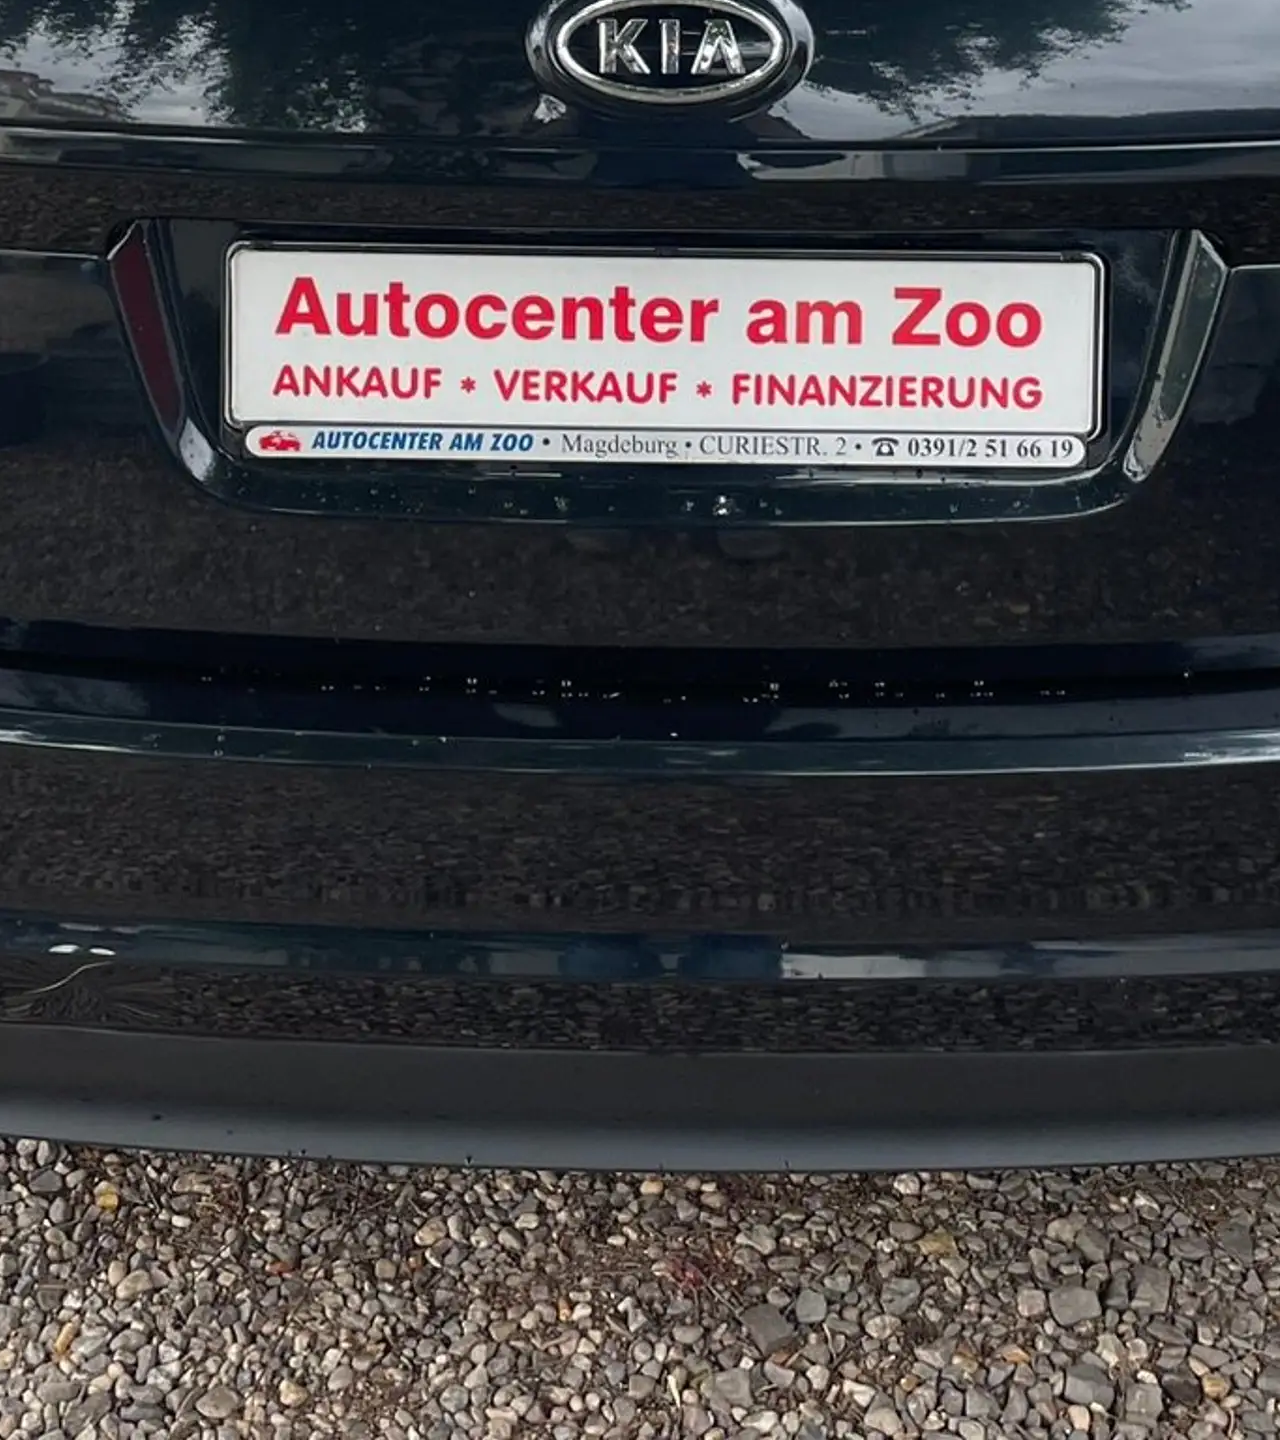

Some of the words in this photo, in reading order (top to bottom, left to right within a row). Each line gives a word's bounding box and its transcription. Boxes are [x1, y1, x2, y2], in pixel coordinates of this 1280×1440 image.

[595, 17, 747, 75] KIA
[275, 275, 719, 344] Autocenter
[746, 297, 863, 345] am
[891, 286, 1042, 348] Zoo
[272, 363, 443, 399] ANKAUF
[493, 368, 678, 405] VERKAUF
[731, 373, 1044, 410] FINANZIERUNG
[311, 430, 442, 452] AUTOCENTER
[449, 432, 483, 452] AM
[490, 432, 534, 452] ZOO
[561, 433, 678, 459] Magdeburg
[699, 435, 828, 457] CURIESTR.
[835, 438, 848, 457] 2
[906, 436, 978, 458] 0391/2
[984, 437, 1008, 458] 51
[1016, 437, 1042, 458] 66
[1051, 437, 1075, 458] 19
